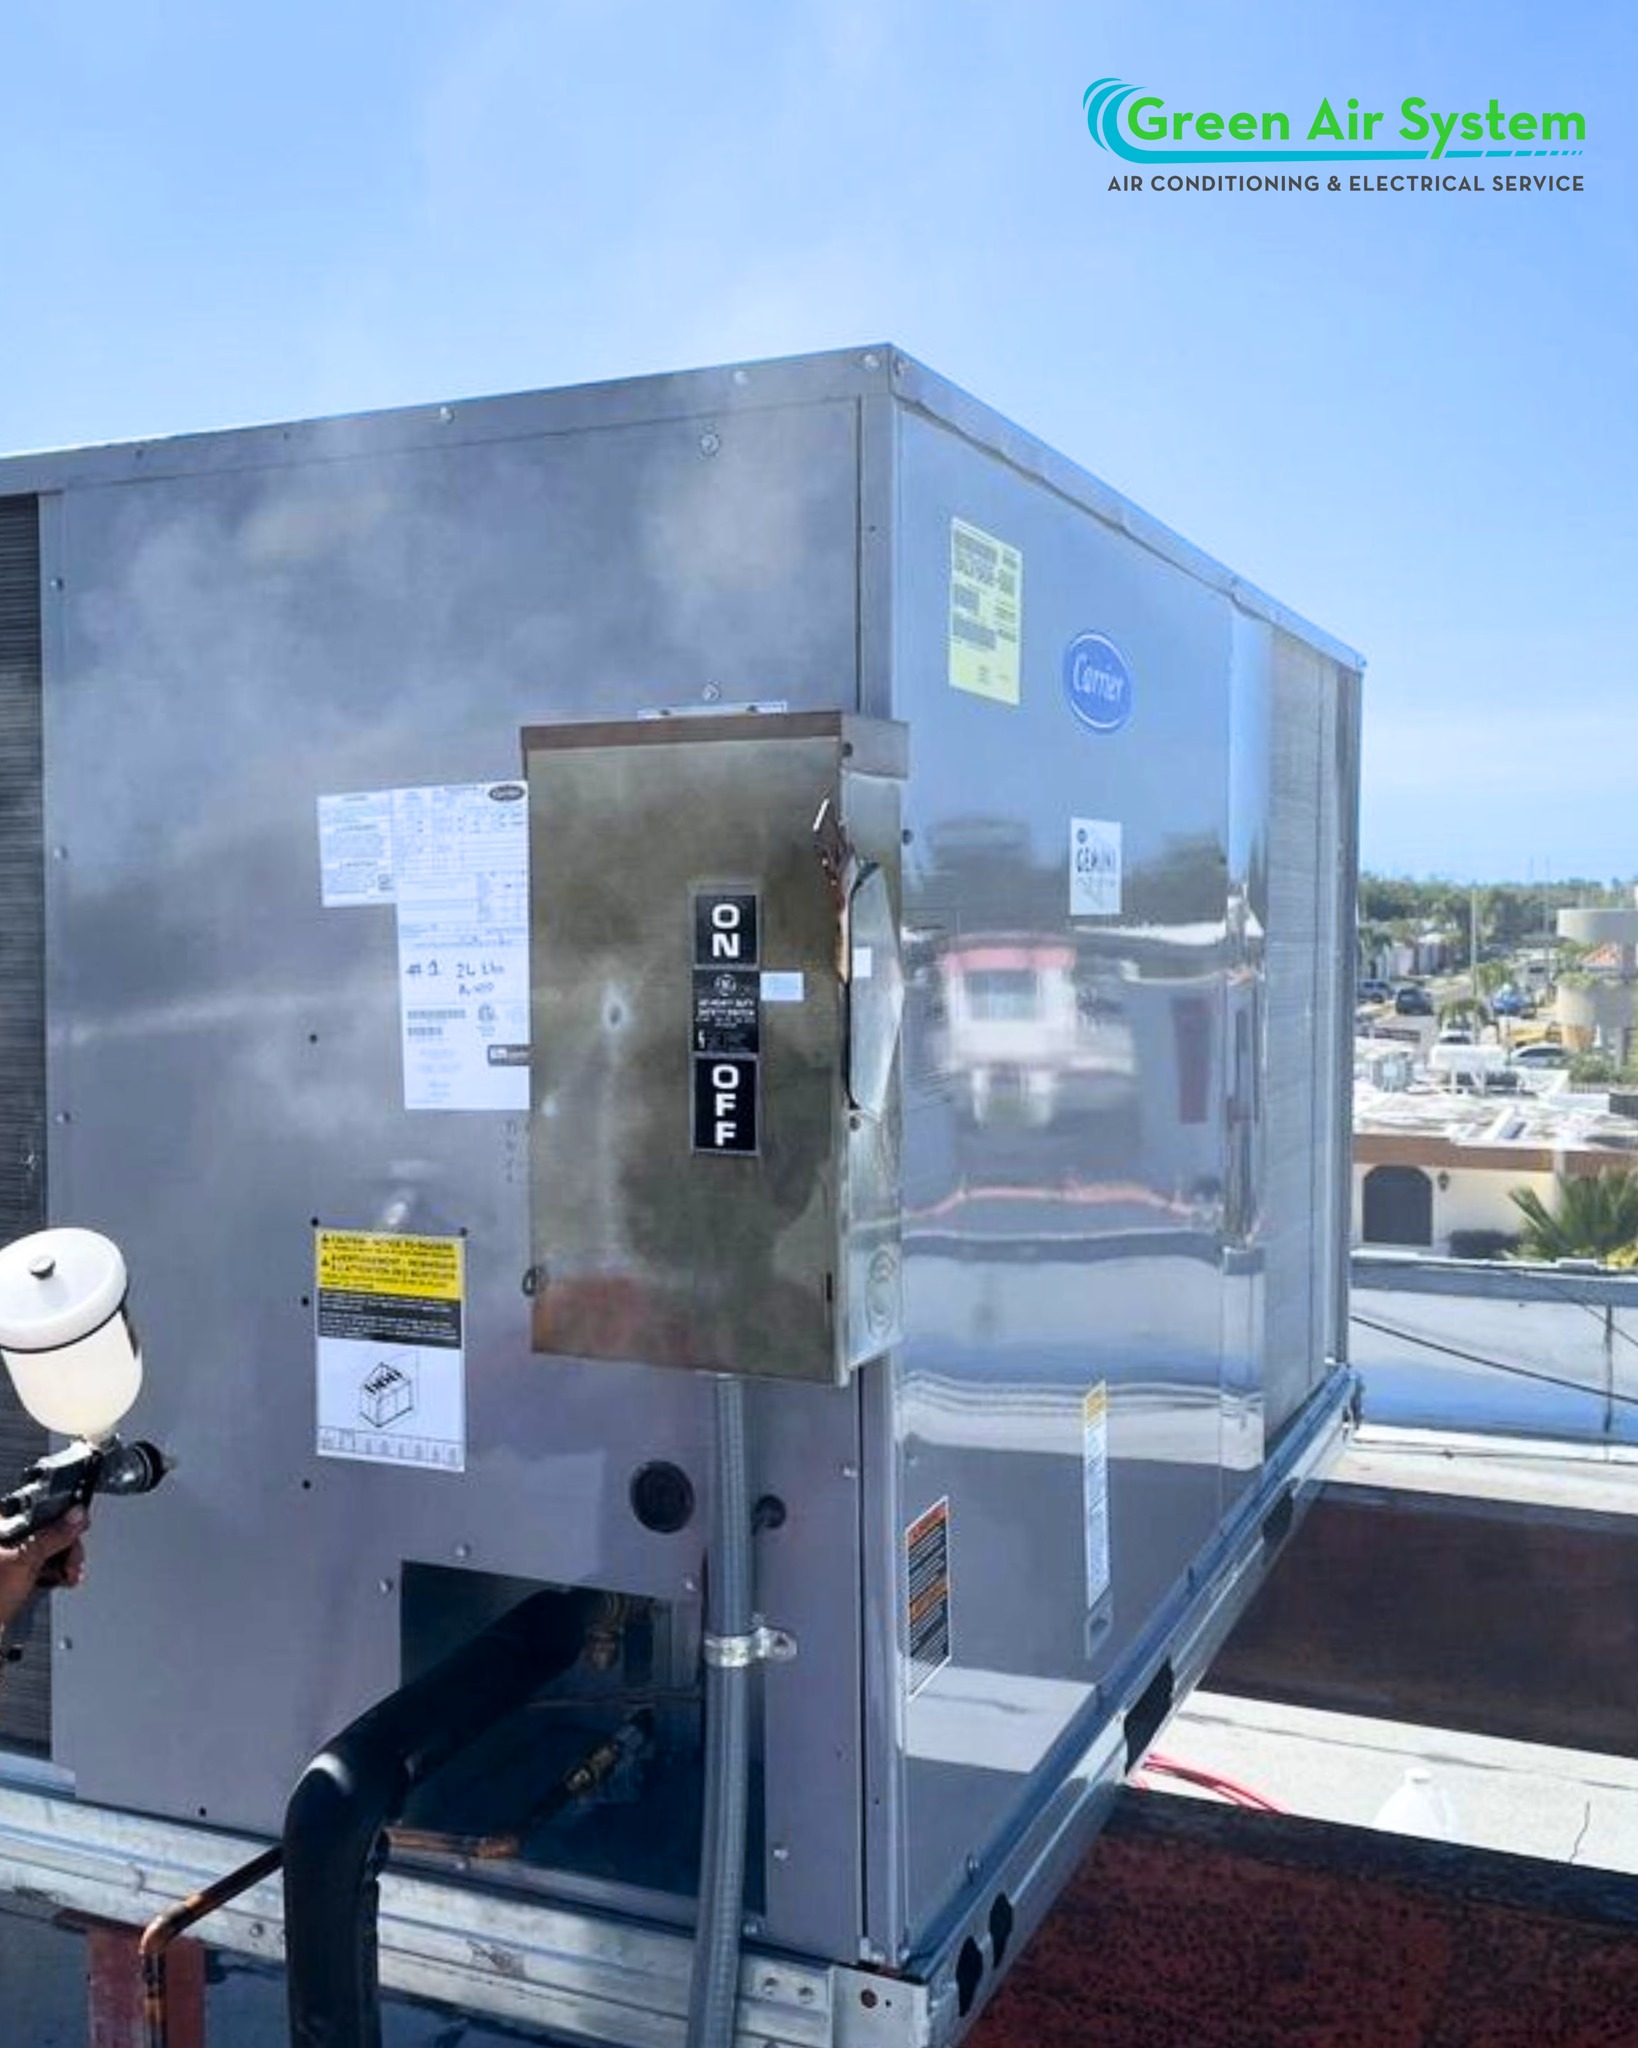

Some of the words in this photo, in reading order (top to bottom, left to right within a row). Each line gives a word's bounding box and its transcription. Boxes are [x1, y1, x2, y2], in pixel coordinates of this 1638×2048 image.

[1072, 653, 1124, 701] Carrier
[712, 903, 740, 957] ON
[712, 1064, 739, 1146] OFF
